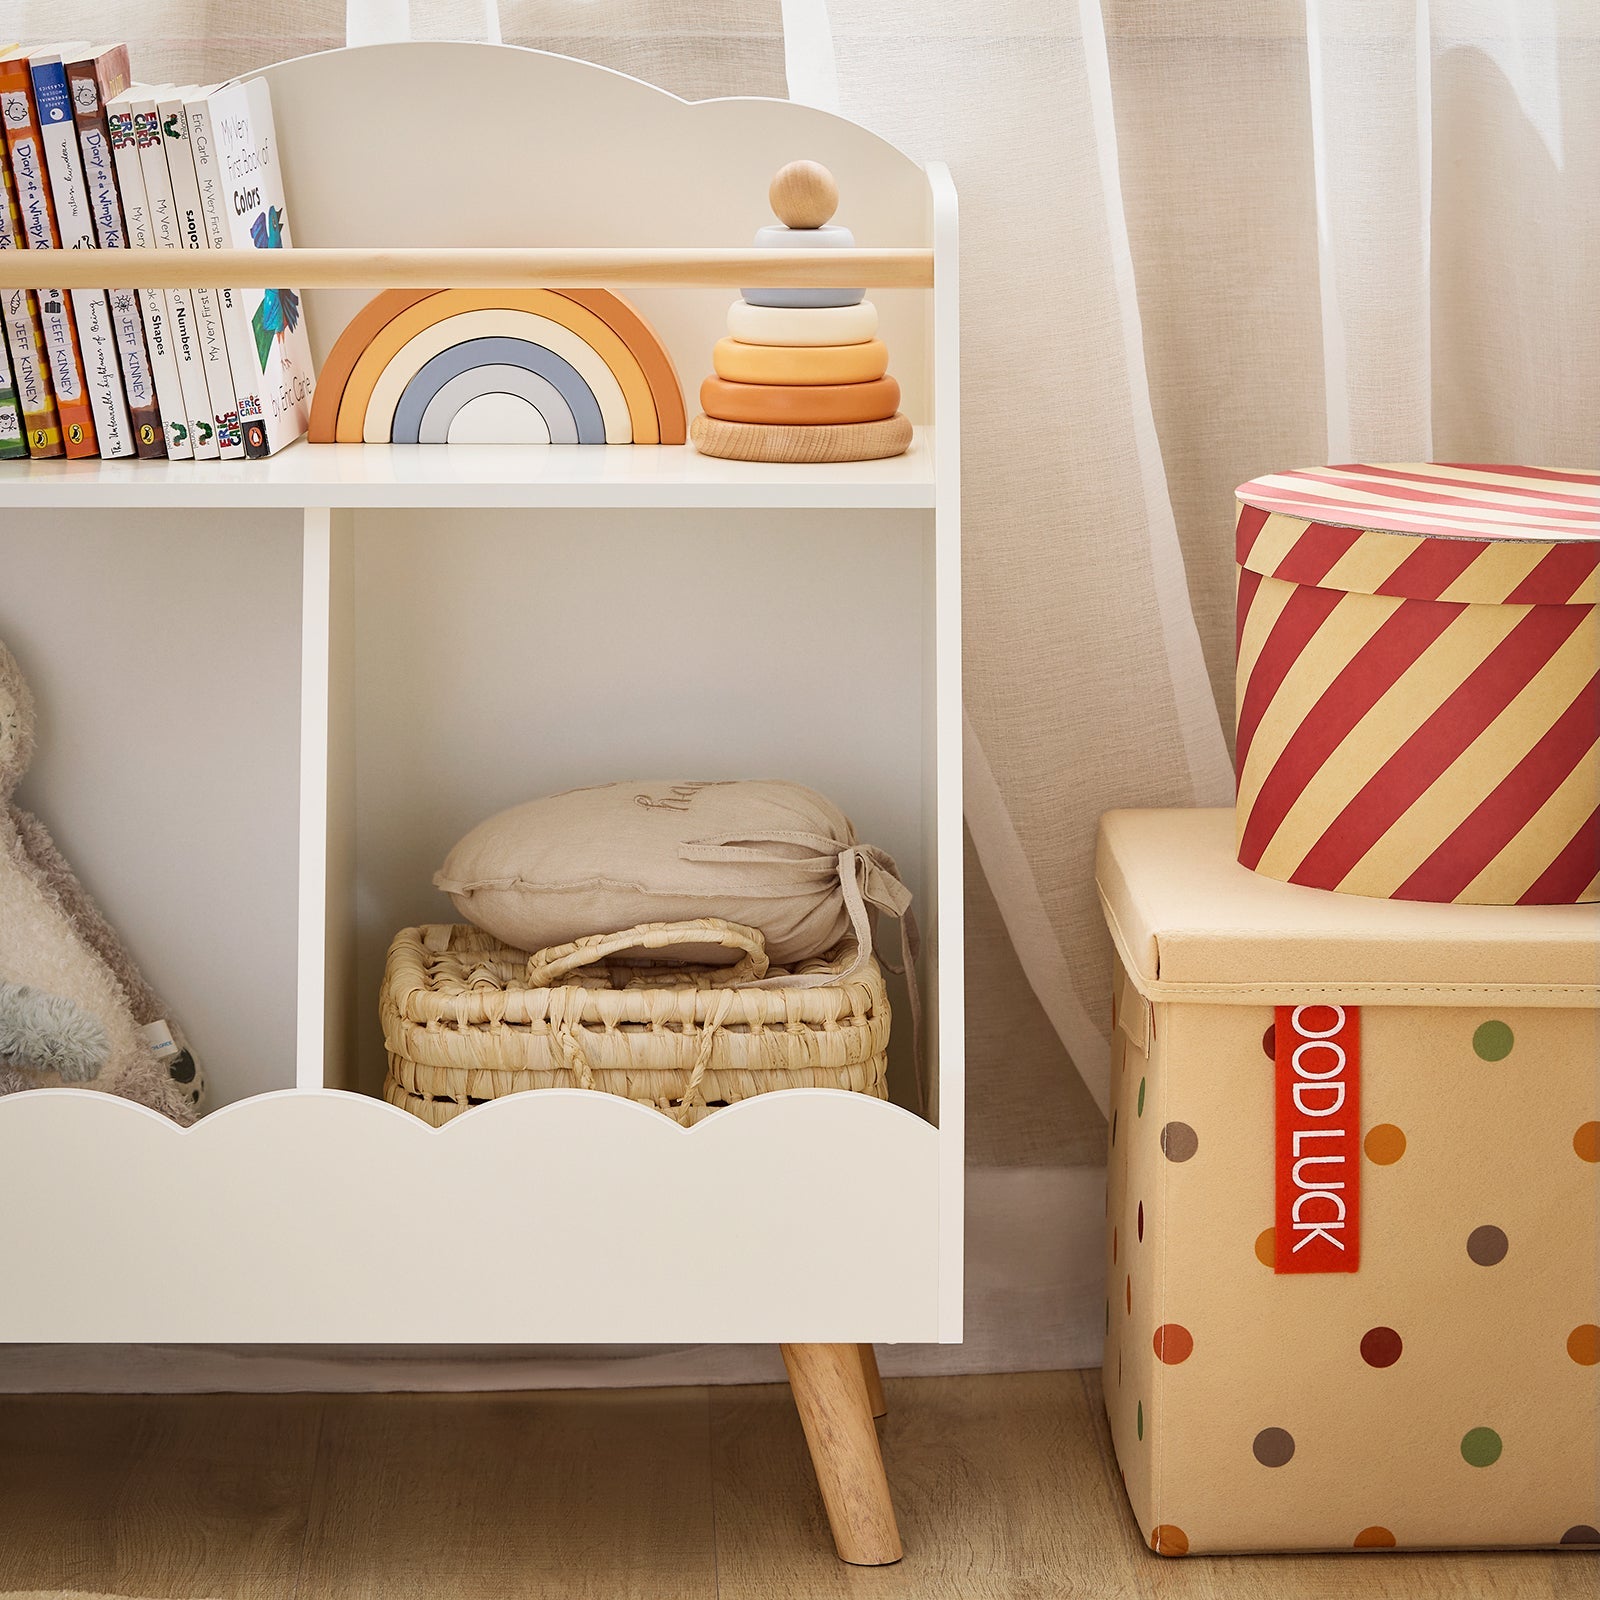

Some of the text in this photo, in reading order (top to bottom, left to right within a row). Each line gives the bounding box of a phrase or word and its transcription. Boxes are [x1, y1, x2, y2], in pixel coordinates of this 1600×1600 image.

[109, 114, 126, 150] CARLE
[119, 113, 136, 147] ERIC
[134, 113, 152, 150] CARLE
[144, 111, 161, 146] ERIC
[17, 144, 35, 179] Diary
[86, 132, 104, 168] Diary
[27, 181, 37, 191] of
[97, 170, 107, 181] of
[192, 113, 223, 249] Eric Carle My Very First Bo
[98, 189, 113, 228] Wimpy
[156, 199, 167, 215] My
[233, 186, 261, 216] Colors
[28, 200, 43, 238] Wimpy
[132, 206, 146, 249] My Very
[160, 215, 170, 241] Very
[105, 230, 119, 249] Kid
[173, 294, 184, 305] of
[200, 295, 212, 318] First
[223, 288, 233, 309] lors
[147, 288, 165, 356] ok of Shapes
[176, 307, 192, 362] Numbers
[206, 319, 216, 345] Very
[15, 321, 39, 405] JEFF KINNEY
[50, 316, 73, 396] JEFF KINNEY
[121, 317, 146, 400] JEFF KINNEY
[208, 345, 220, 362] My
[89, 299, 122, 455] The Unbearable Lightness of Being
[279, 384, 294, 411] Eric
[292, 371, 312, 402] Carle
[238, 397, 260, 409] ERIC
[240, 406, 262, 417] CARLE
[215, 414, 232, 448] ERIC
[225, 411, 242, 446] CARLE
[1291, 1005, 1346, 1253] OOD LUCK
